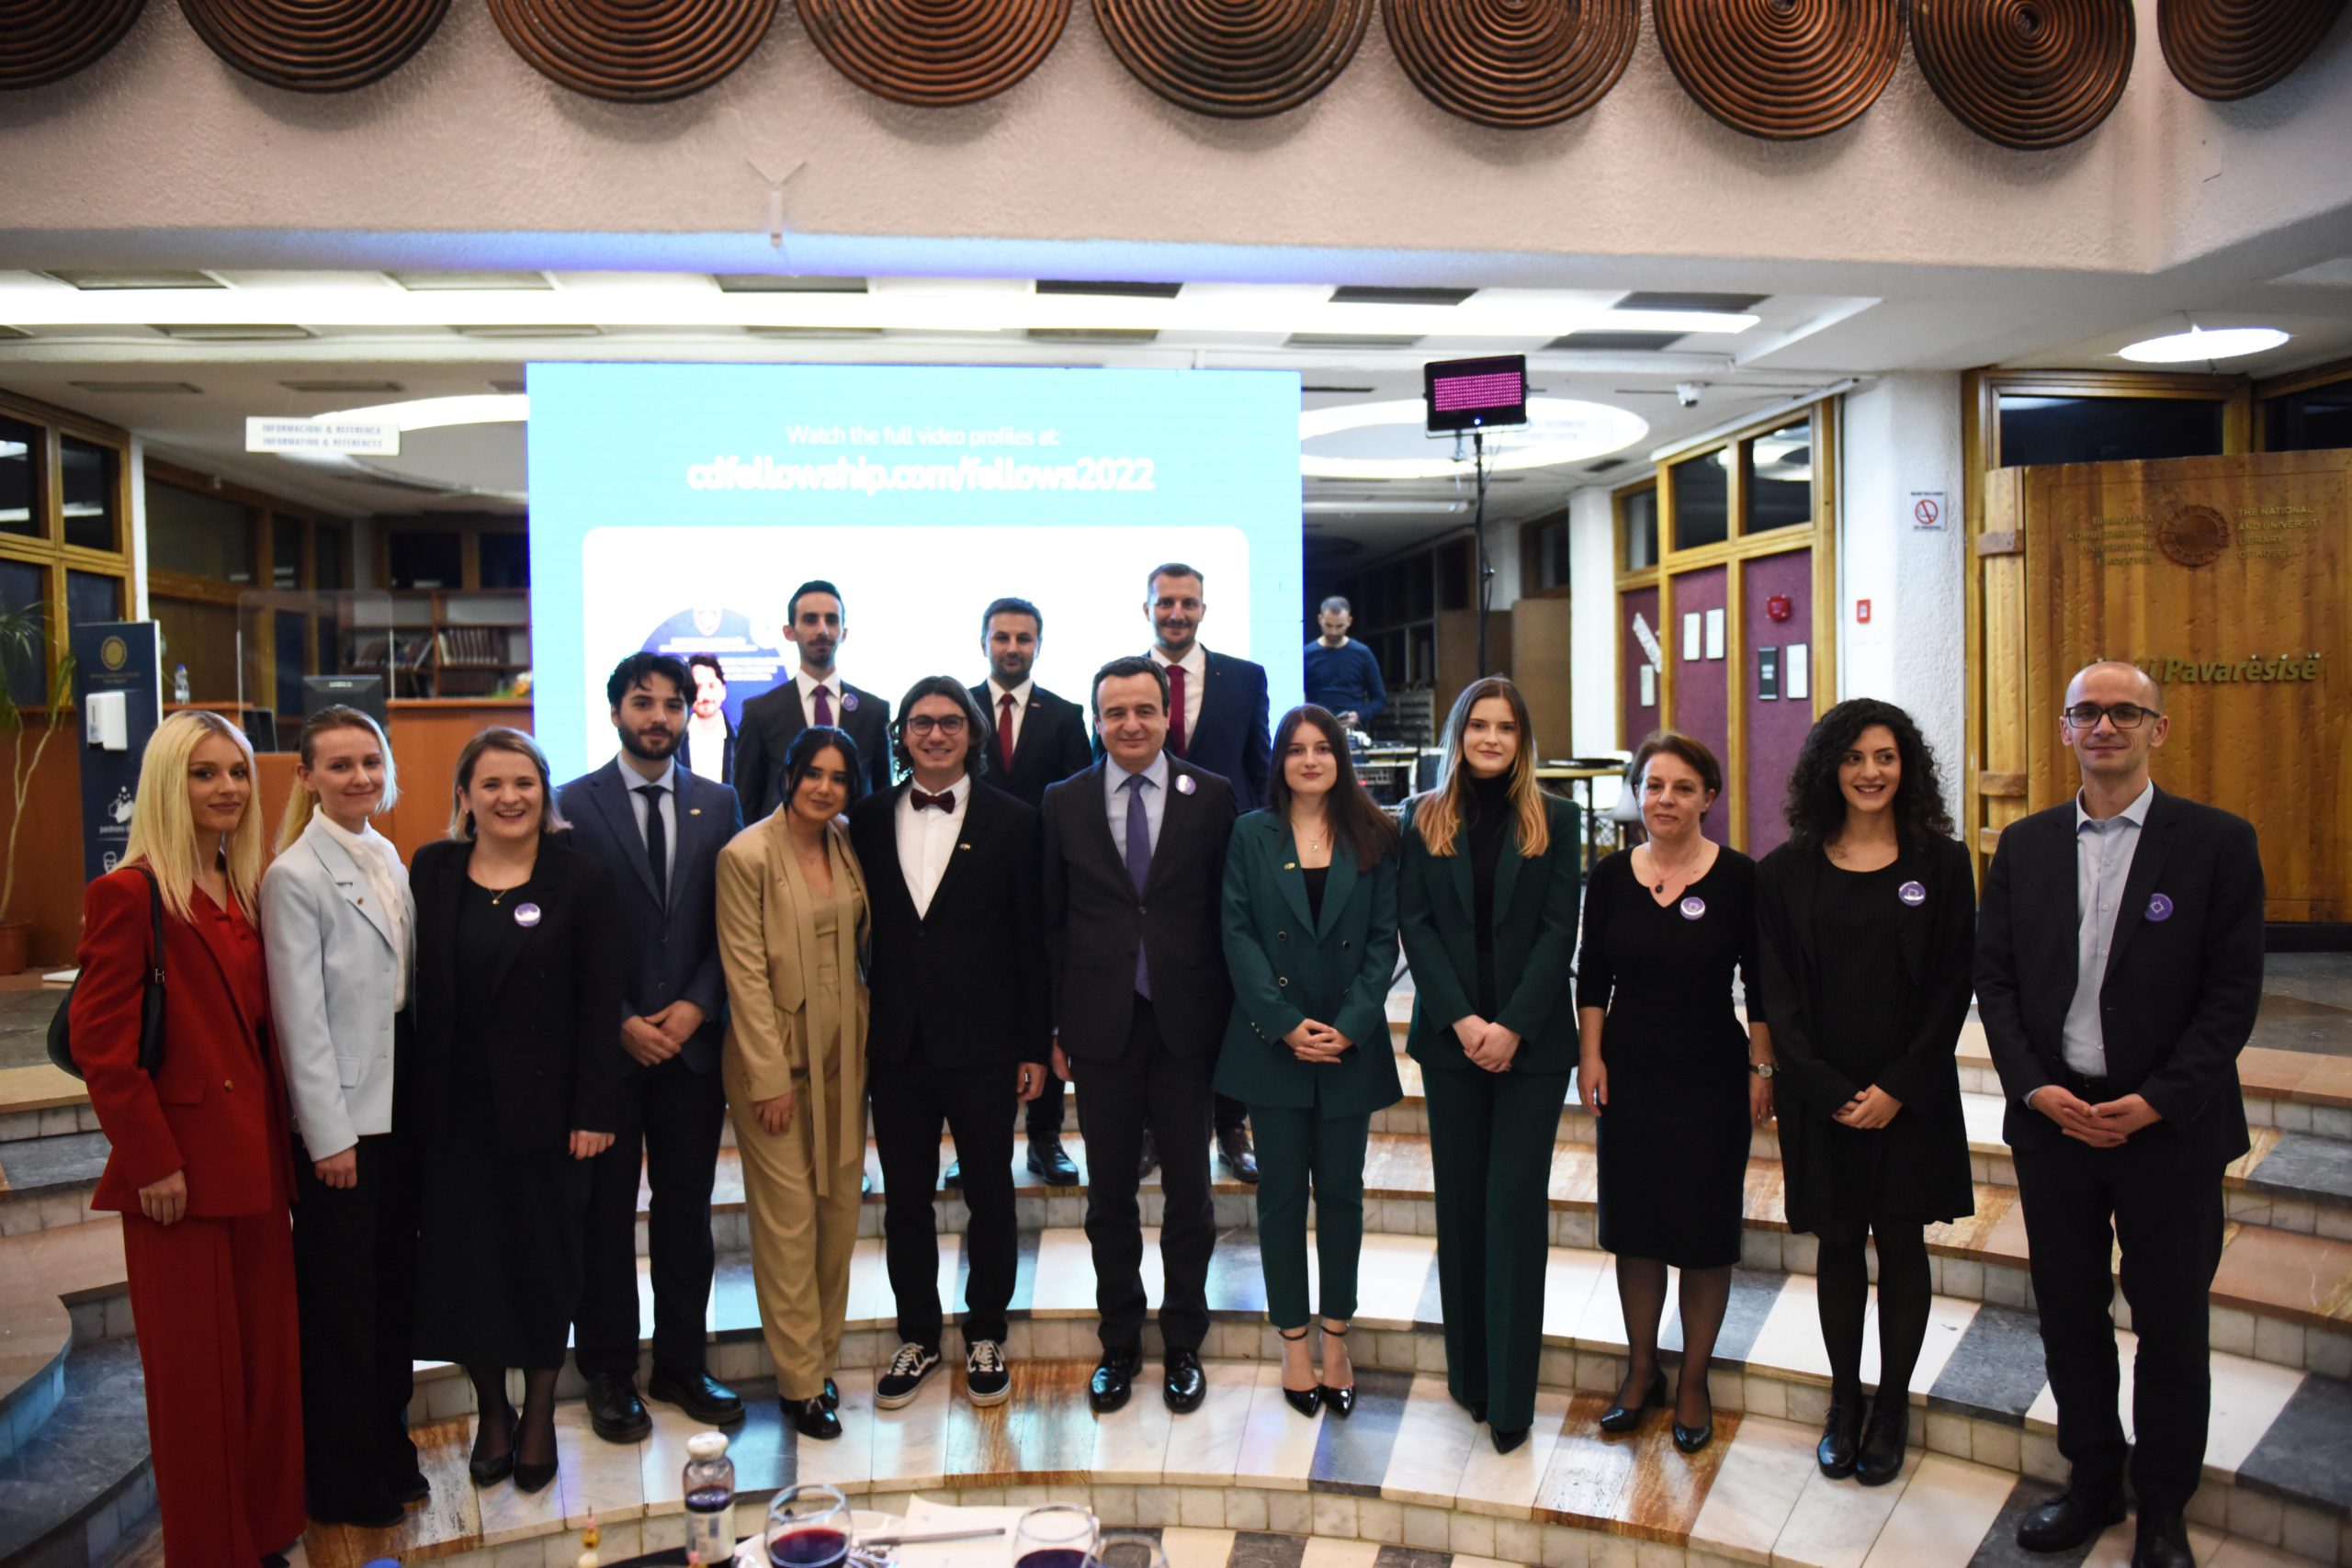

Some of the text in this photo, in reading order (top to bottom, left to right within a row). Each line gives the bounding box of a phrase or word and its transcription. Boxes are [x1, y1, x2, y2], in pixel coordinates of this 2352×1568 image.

[326, 425, 332, 434] &
[786, 424, 845, 446] Watch
[850, 425, 879, 446] the
[882, 425, 914, 446] full
[917, 426, 965, 446] video
[969, 426, 1035, 448] profiles
[263, 438, 319, 446] INFORMATION
[322, 439, 331, 447] &
[686, 455, 1157, 496] cdfellowship.com/fellows2022
[2238, 505, 2315, 517] THE NATIONAL
[2238, 518, 2324, 531] AND UNIVERSITY
[2238, 536, 2283, 546] LIBRARY
[2238, 550, 2254, 559] OF
[2163, 651, 2322, 683] Pavarësisë
